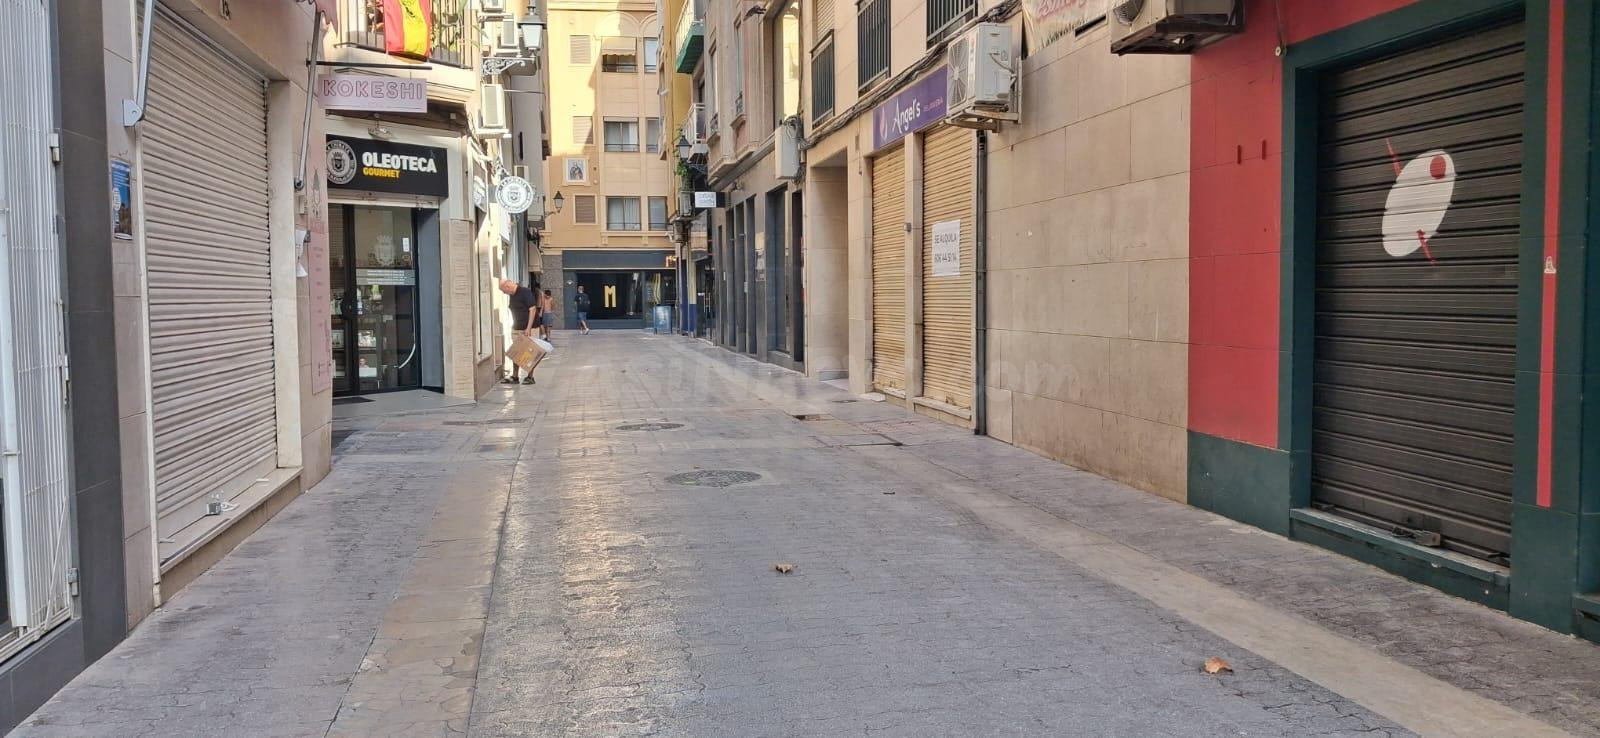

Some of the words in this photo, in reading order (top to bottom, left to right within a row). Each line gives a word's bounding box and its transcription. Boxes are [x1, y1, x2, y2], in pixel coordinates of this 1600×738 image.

[323, 79, 423, 100] KOKESHI
[892, 96, 921, 134] Angel's
[362, 152, 437, 173] OLEOTECA
[362, 167, 401, 178] GOURMET
[604, 285, 616, 308] M
